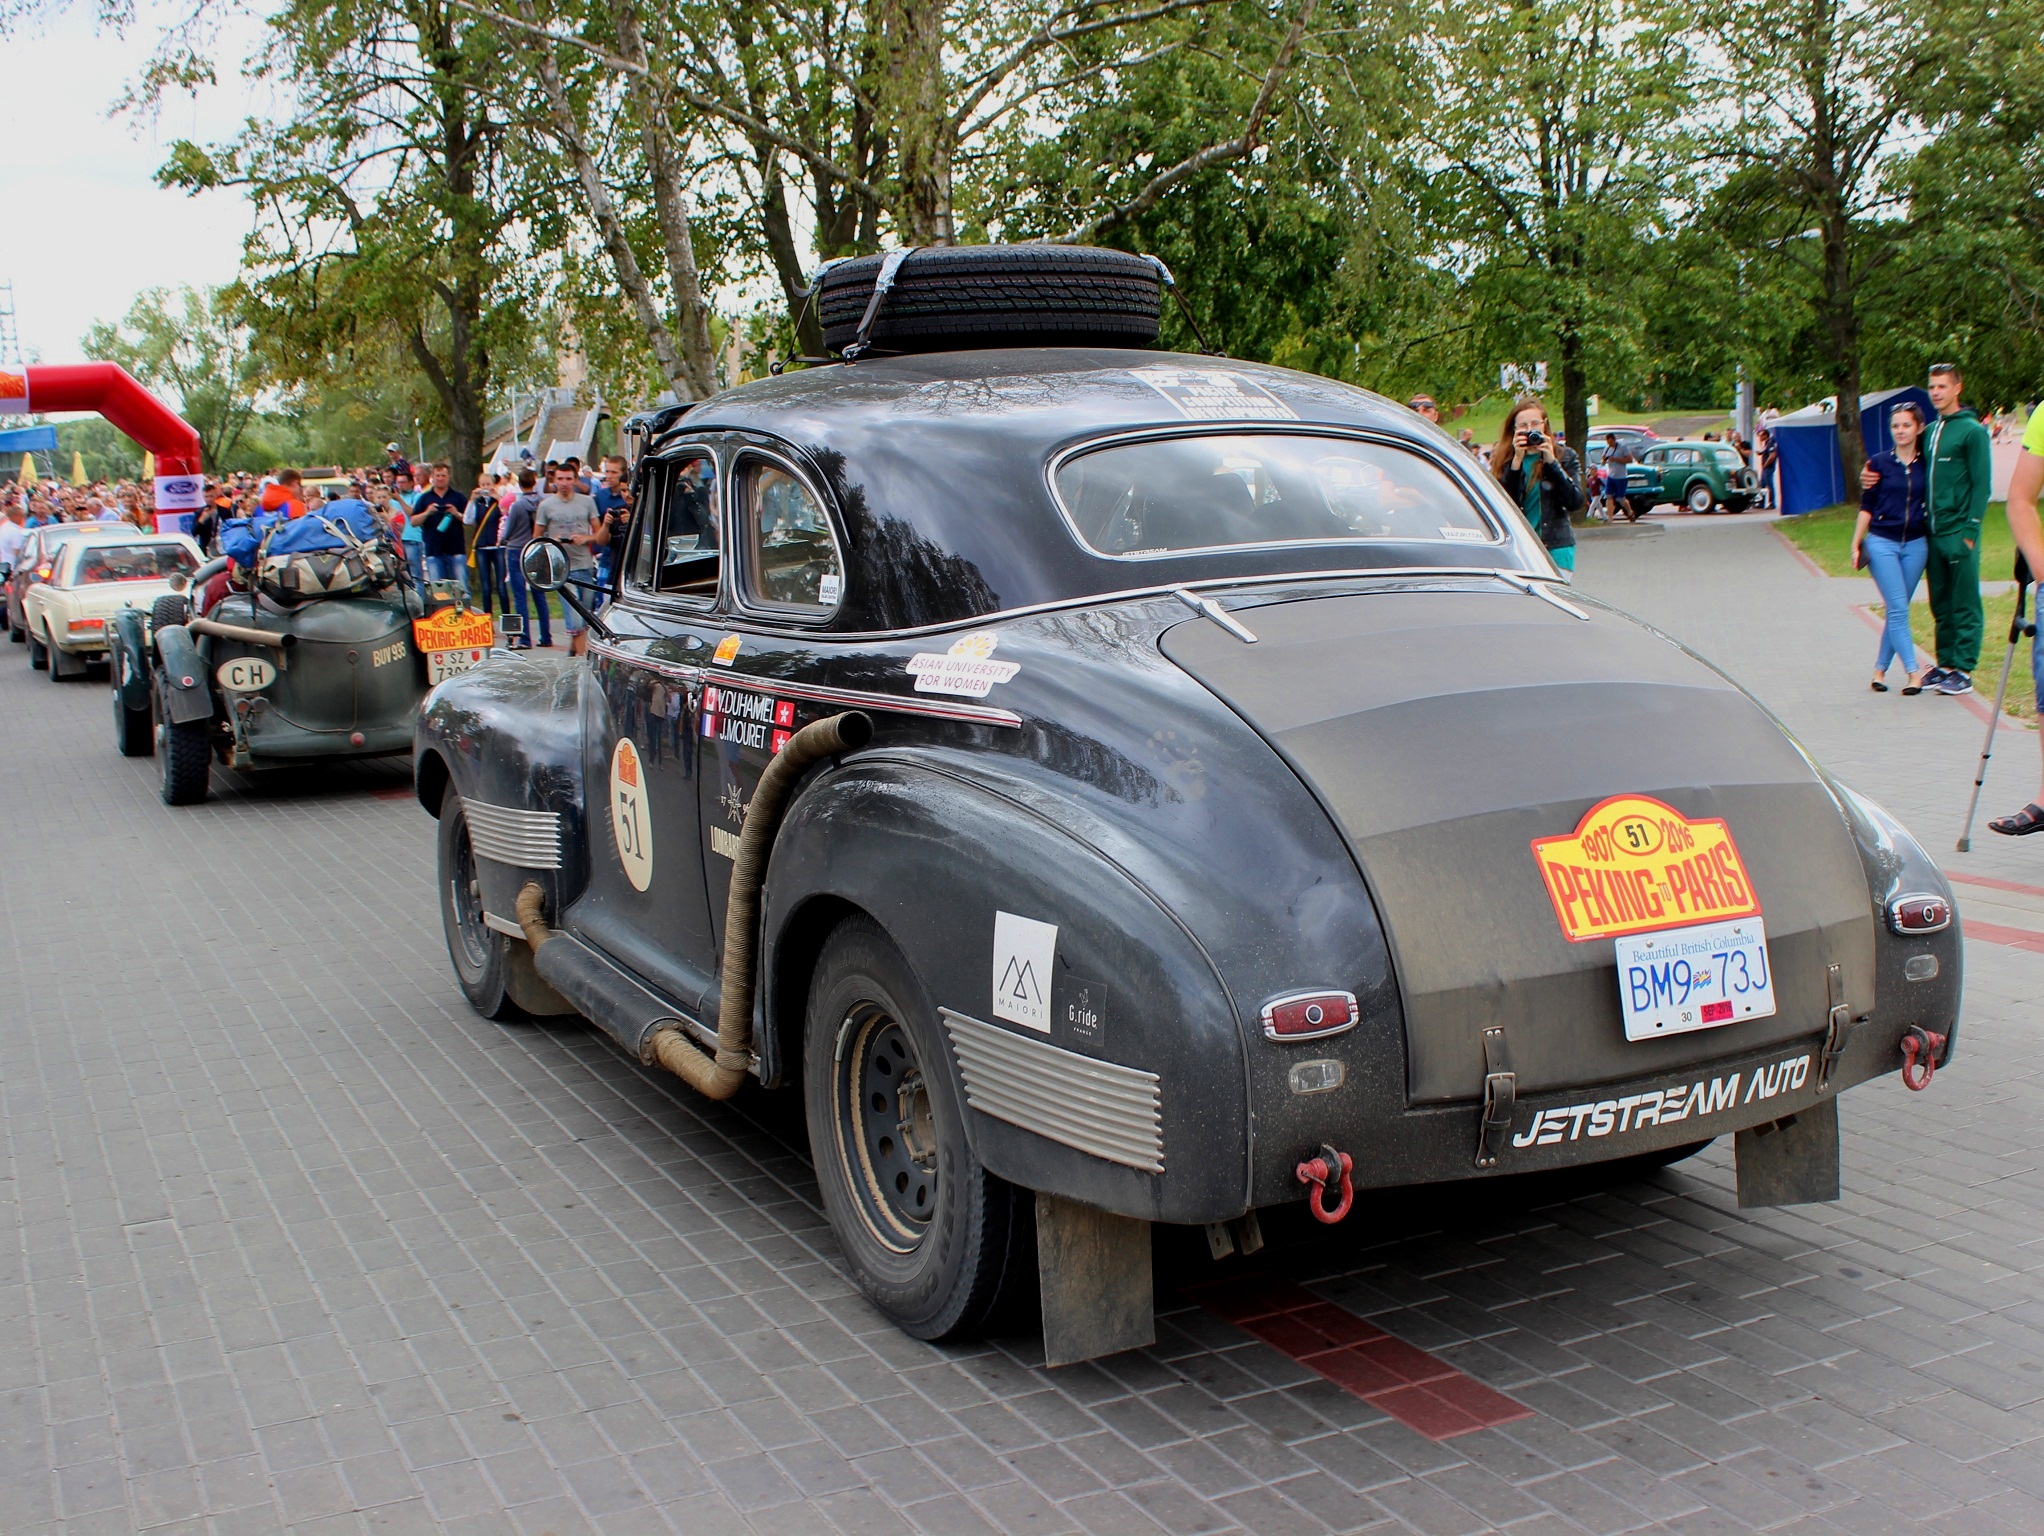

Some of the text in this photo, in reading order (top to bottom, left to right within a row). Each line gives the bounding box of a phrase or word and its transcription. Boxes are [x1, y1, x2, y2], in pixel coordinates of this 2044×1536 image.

[1180, 396, 1276, 407] COMPETITION
[1187, 387, 1244, 397] PACIFIC
[1186, 406, 1295, 419] DEVELOPMENTS
[418, 627, 457, 650] PEKING
[460, 622, 491, 647] PARIS
[391, 641, 406, 661] 935
[450, 652, 464, 664] SZ
[232, 665, 263, 686] CH
[911, 658, 1014, 678] ASIAN UNIVERSITY
[919, 674, 988, 691] FOR WOMEN
[717, 689, 775, 724] V.DUHAMEL
[720, 717, 767, 749] J.MOURET
[619, 791, 645, 861] 51
[1581, 817, 1695, 862] 1907 51 2016
[1546, 840, 1749, 930] PEKING TO PARIS
[1632, 933, 1755, 963] Beautiful British Columbia
[1629, 945, 1768, 1013] BM9 73J
[998, 997, 1044, 1019] MAIORI
[1069, 1004, 1098, 1029] G.ride
[1681, 1012, 1693, 1023] 30
[1703, 1005, 1715, 1017] SEP
[1512, 1054, 1811, 1148] JETSTREAM AUTO
